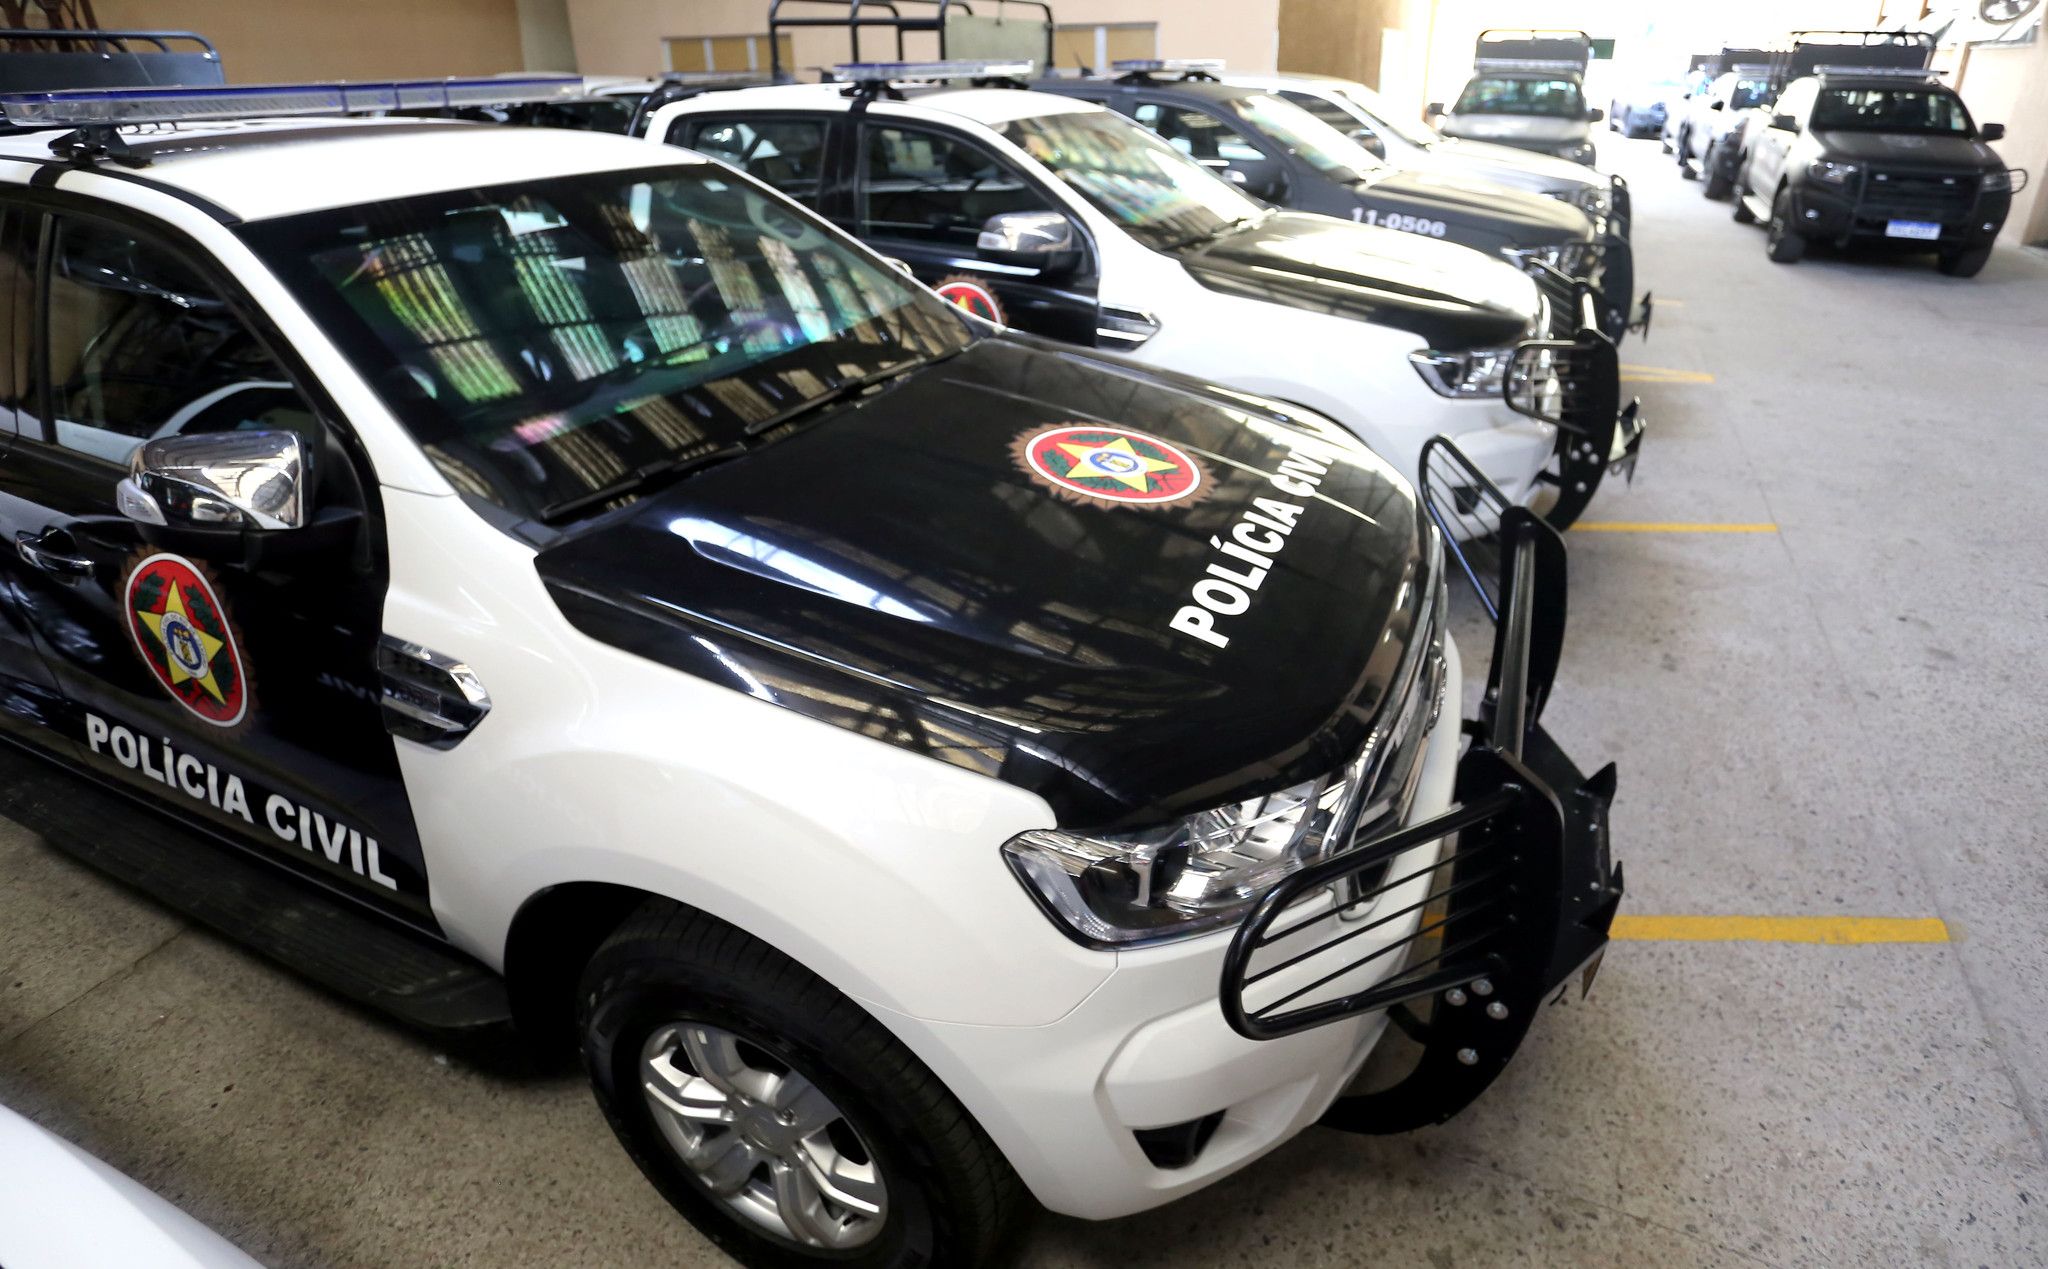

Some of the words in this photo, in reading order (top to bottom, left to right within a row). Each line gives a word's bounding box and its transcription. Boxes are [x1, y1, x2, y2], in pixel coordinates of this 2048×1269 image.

[1351, 206, 1447, 238] 11-0506
[1169, 496, 1304, 649] POLÍCIA
[1269, 440, 1336, 497] CIVI
[86, 712, 254, 824] POLÍCIA
[265, 793, 398, 891] CIVIL
